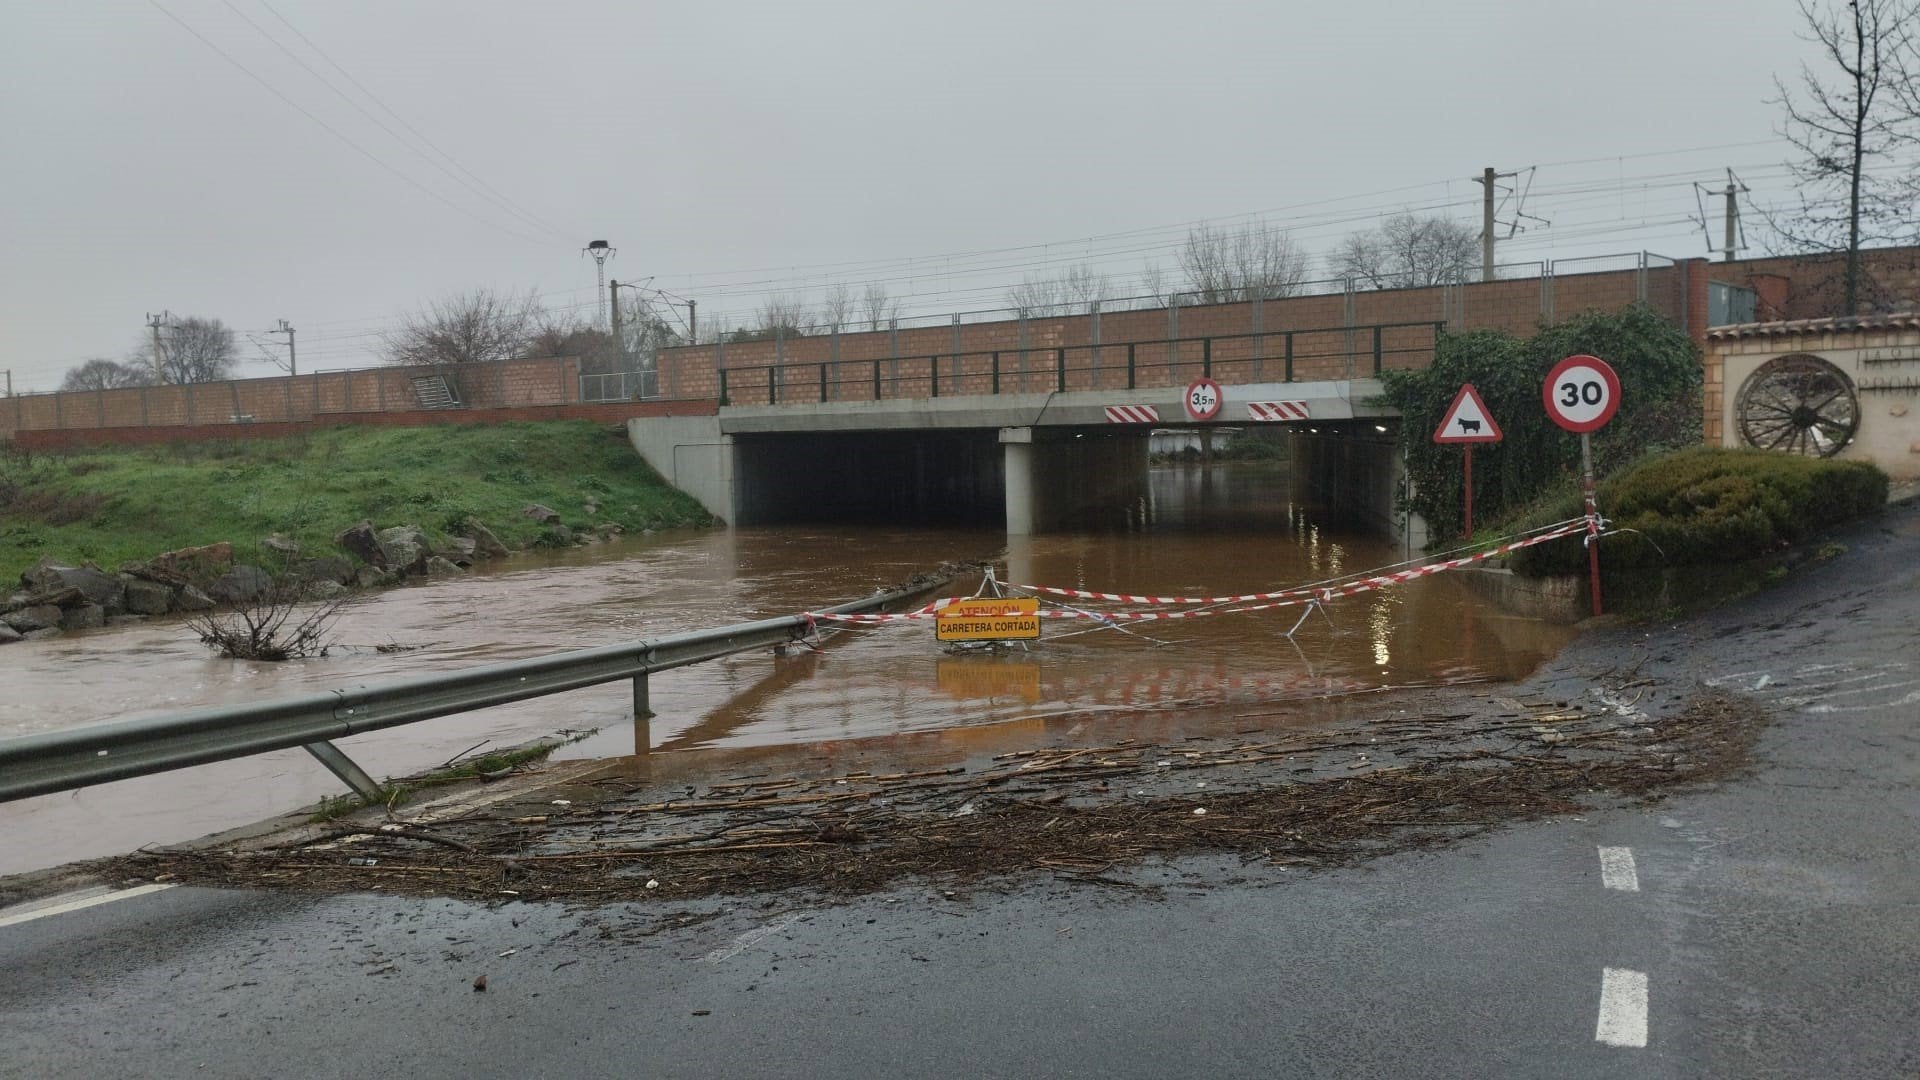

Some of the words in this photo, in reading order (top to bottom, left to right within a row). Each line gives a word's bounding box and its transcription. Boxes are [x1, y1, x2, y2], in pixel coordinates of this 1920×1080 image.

[1560, 381, 1603, 407] 30
[940, 621, 993, 634] CARRETERA
[994, 620, 1037, 632] CORTADA
